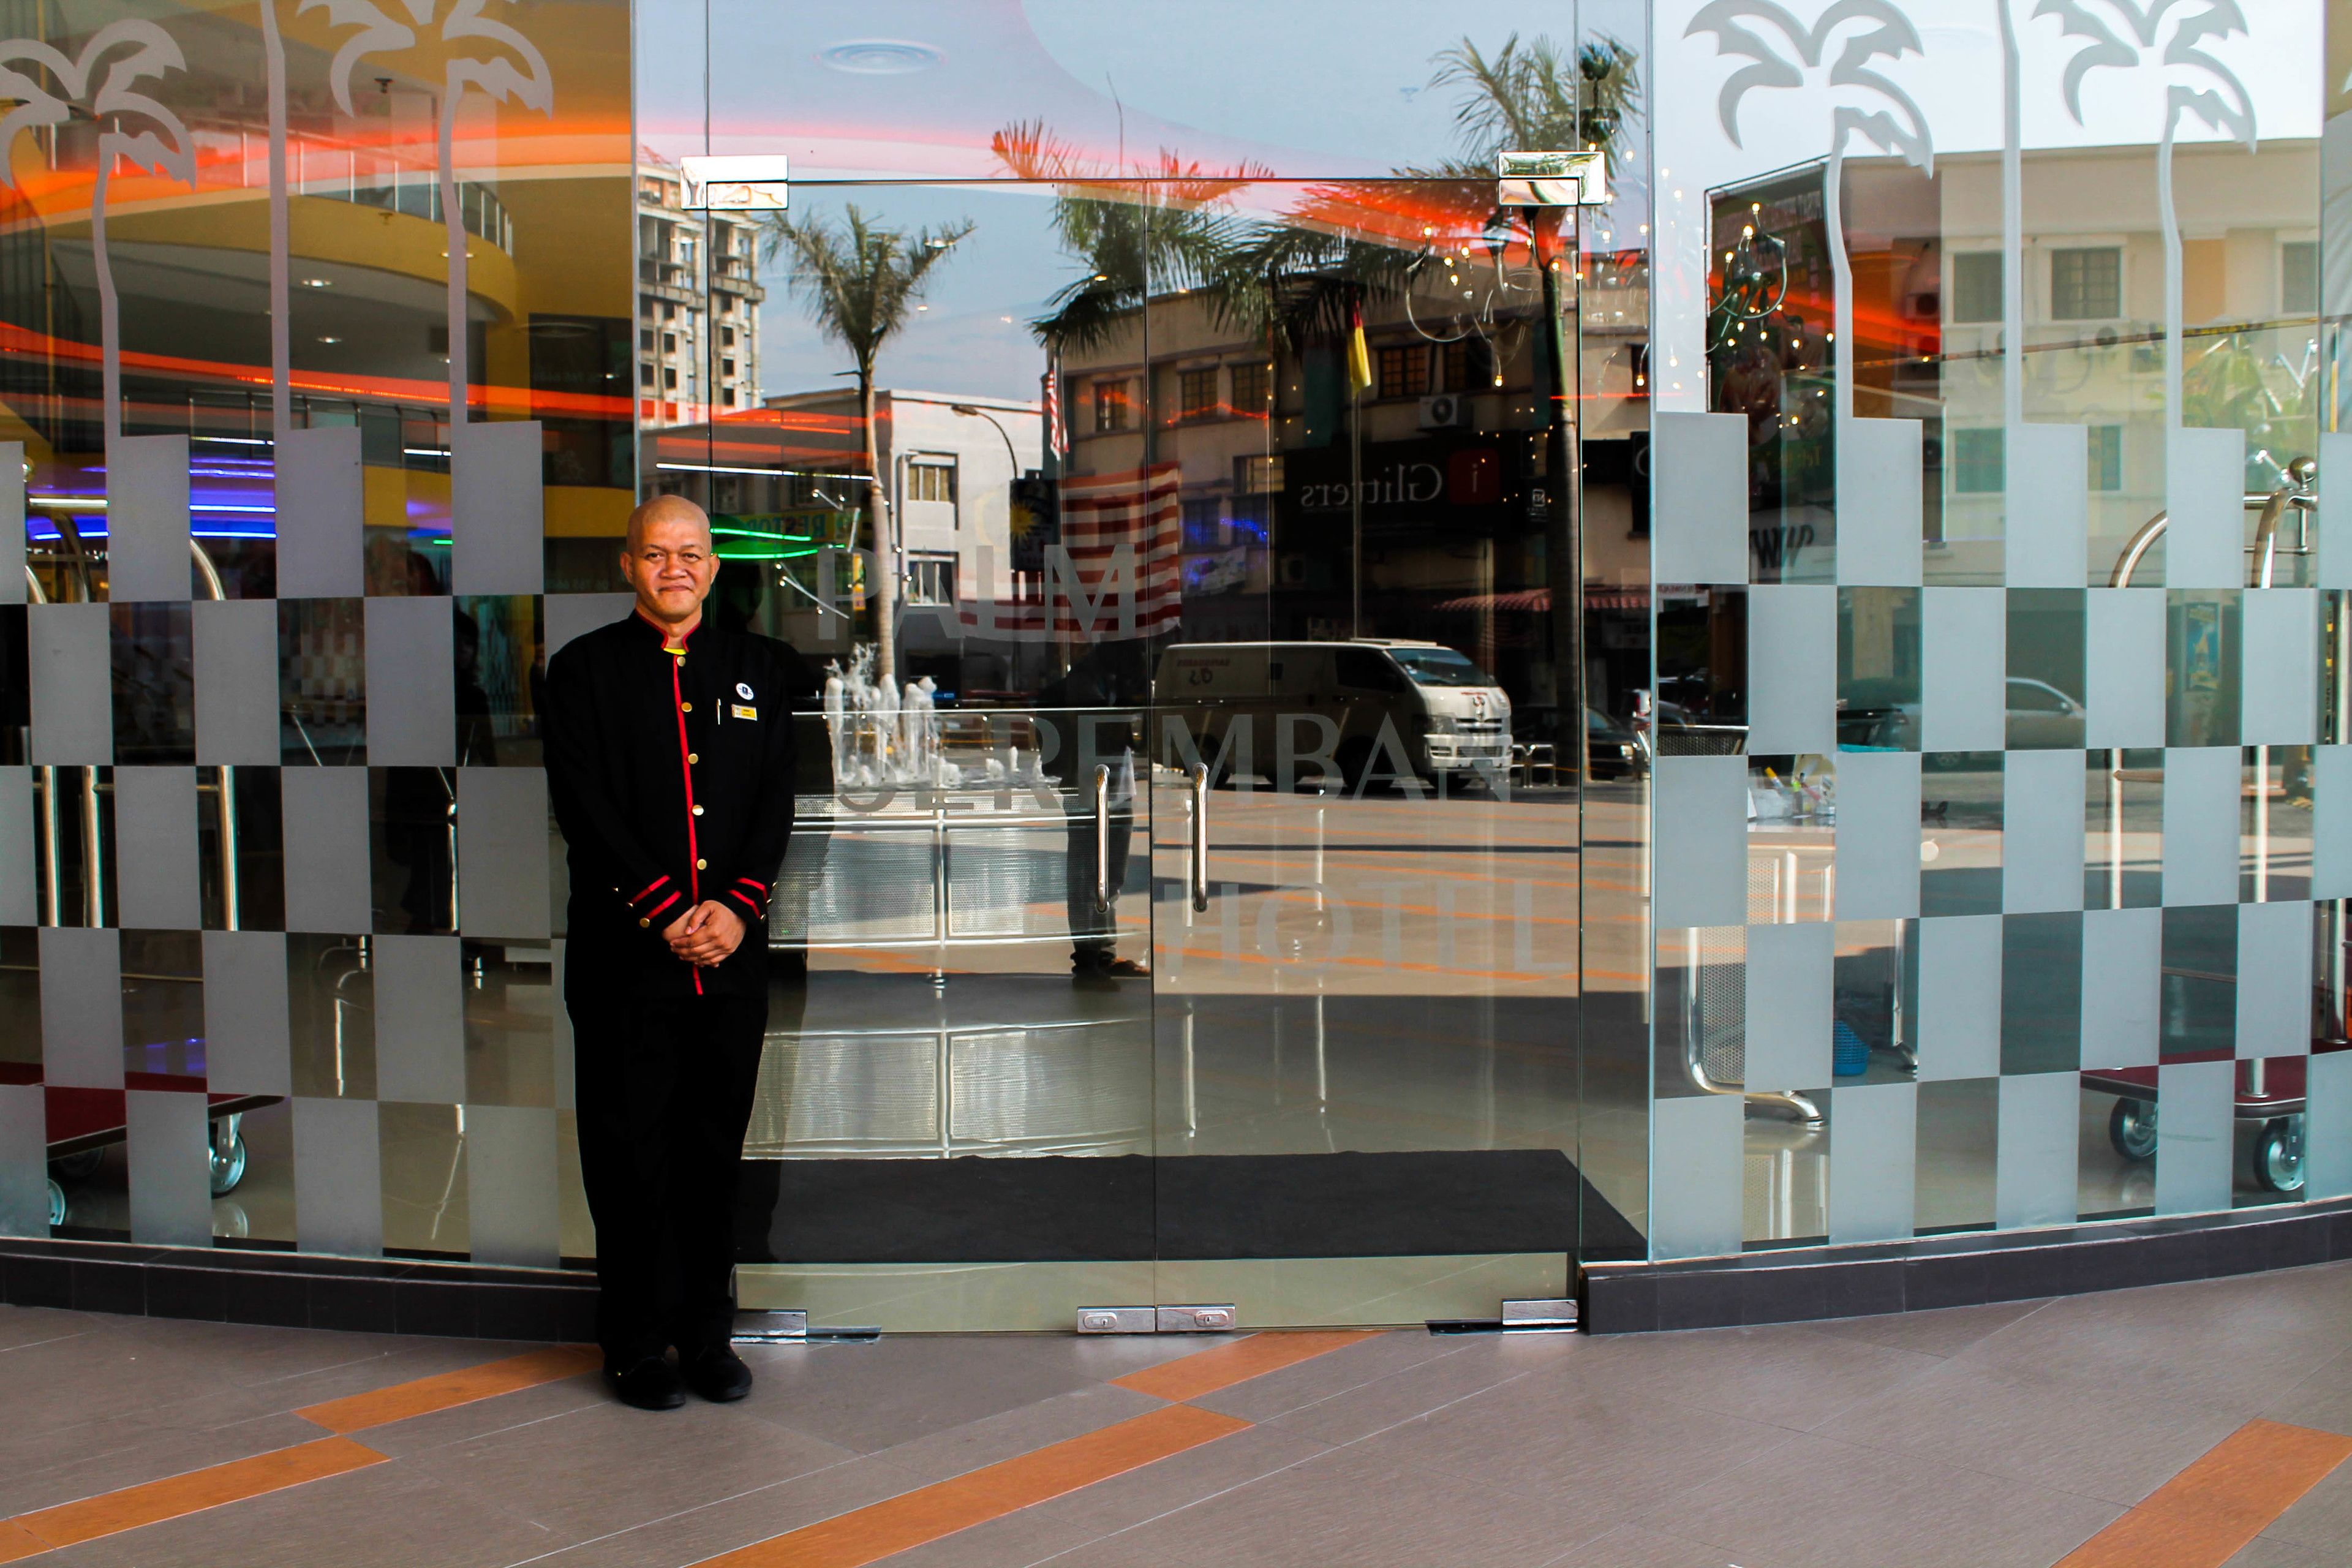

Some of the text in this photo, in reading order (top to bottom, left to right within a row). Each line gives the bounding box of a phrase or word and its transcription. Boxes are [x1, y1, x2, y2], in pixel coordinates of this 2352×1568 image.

[816, 544, 1137, 641] PALM
[837, 712, 1511, 813] SEREMBAN
[1164, 880, 1572, 976] HOTEL
